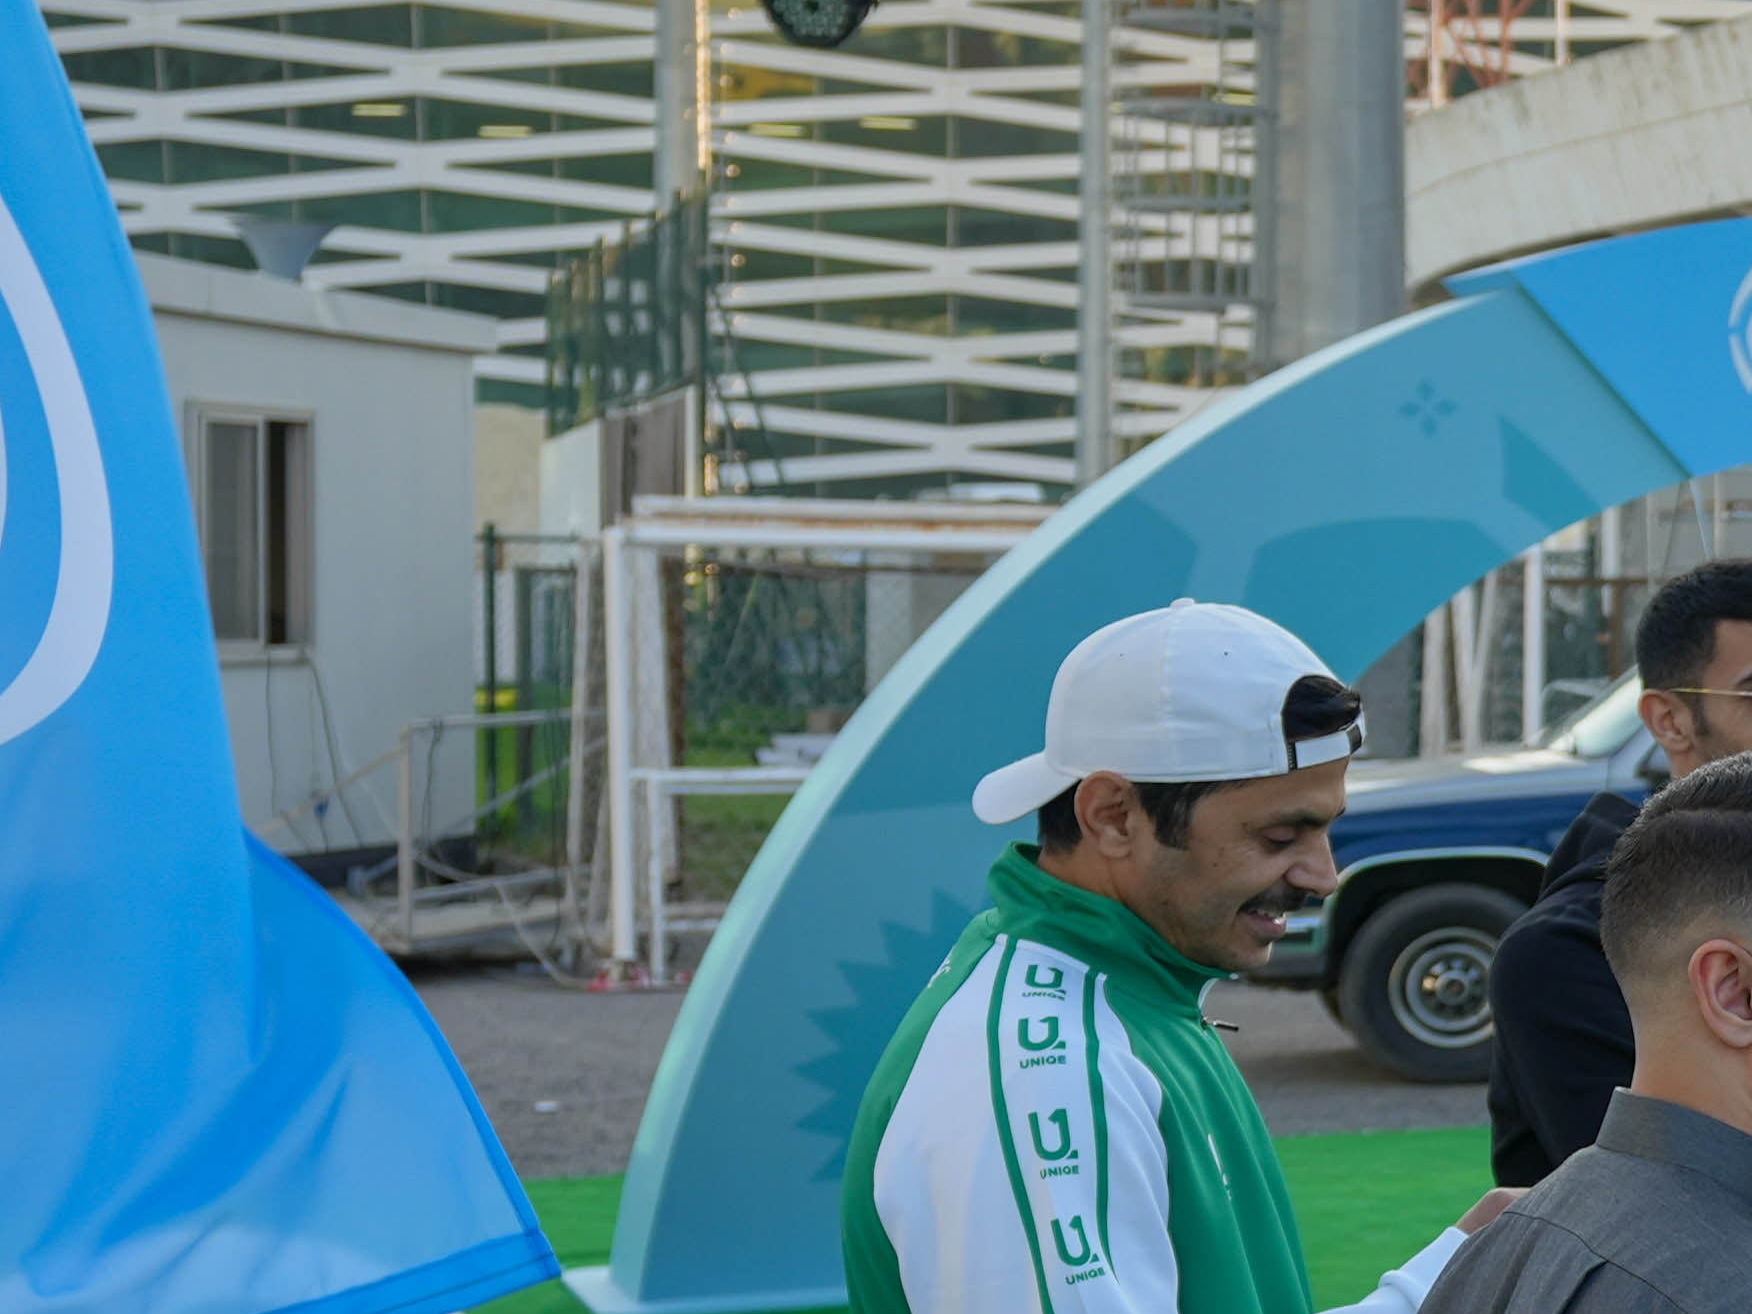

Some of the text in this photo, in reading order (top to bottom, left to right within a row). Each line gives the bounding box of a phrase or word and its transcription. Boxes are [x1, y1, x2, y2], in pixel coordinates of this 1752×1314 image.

[1019, 1055, 1067, 1070] UNIQE
[1040, 1165, 1080, 1179] UNIQE
[1066, 1267, 1105, 1285] UNIQE
